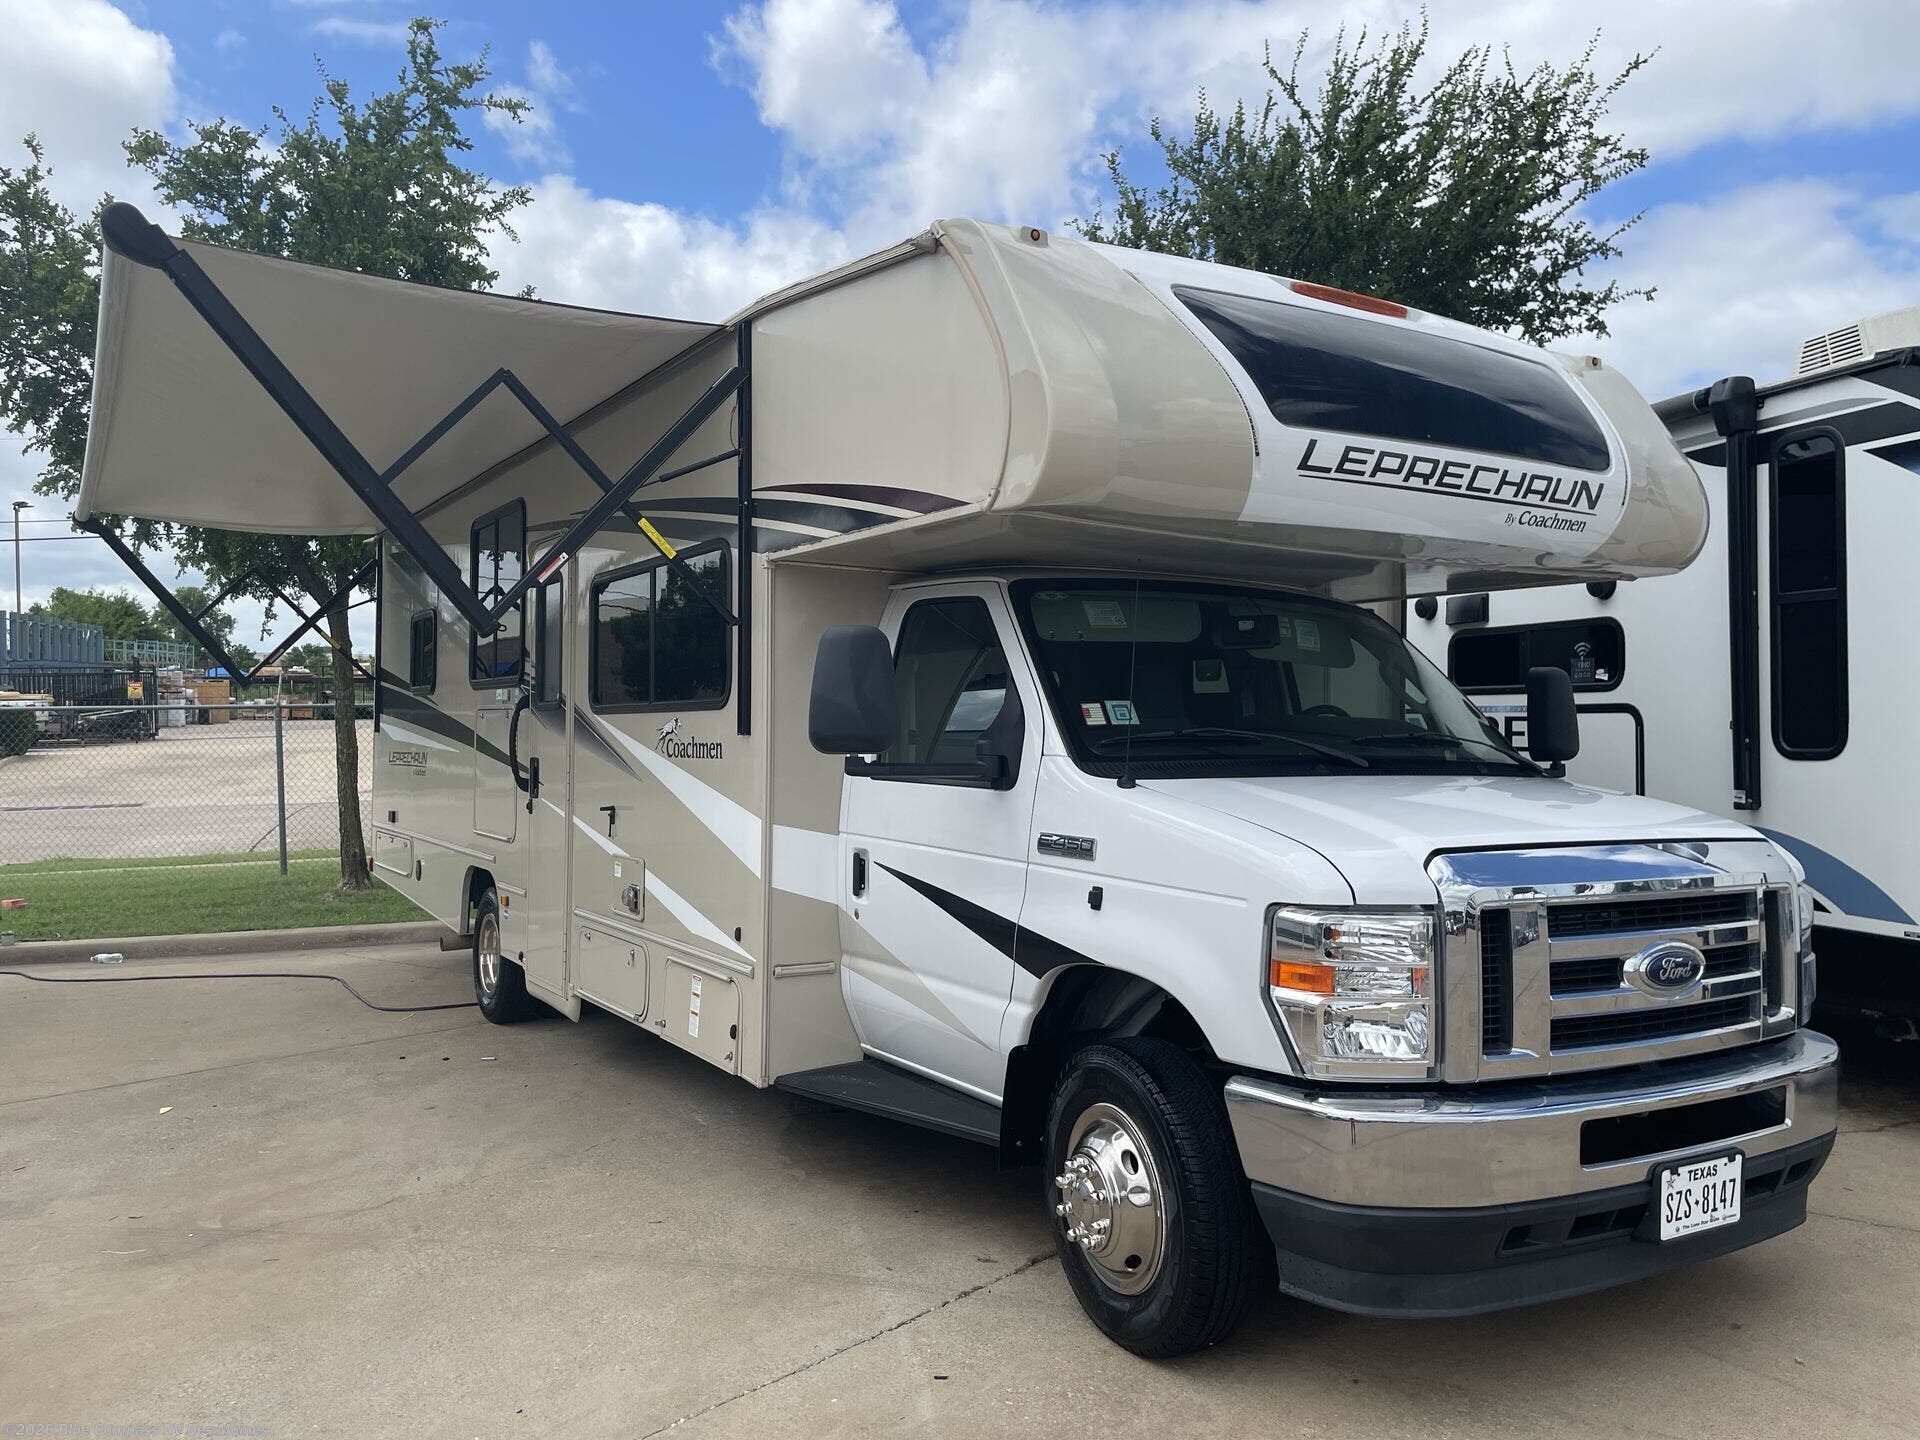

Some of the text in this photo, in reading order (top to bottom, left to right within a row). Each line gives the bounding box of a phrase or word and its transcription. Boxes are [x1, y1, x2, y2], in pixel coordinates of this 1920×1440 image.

[1296, 438, 1604, 510] LEPRECHAUN
[1504, 510, 1587, 532] By Coachmen
[666, 735, 723, 759] Coachmen
[1660, 957, 1692, 980] Ford
[1687, 1164, 1718, 1182] TEXAS
